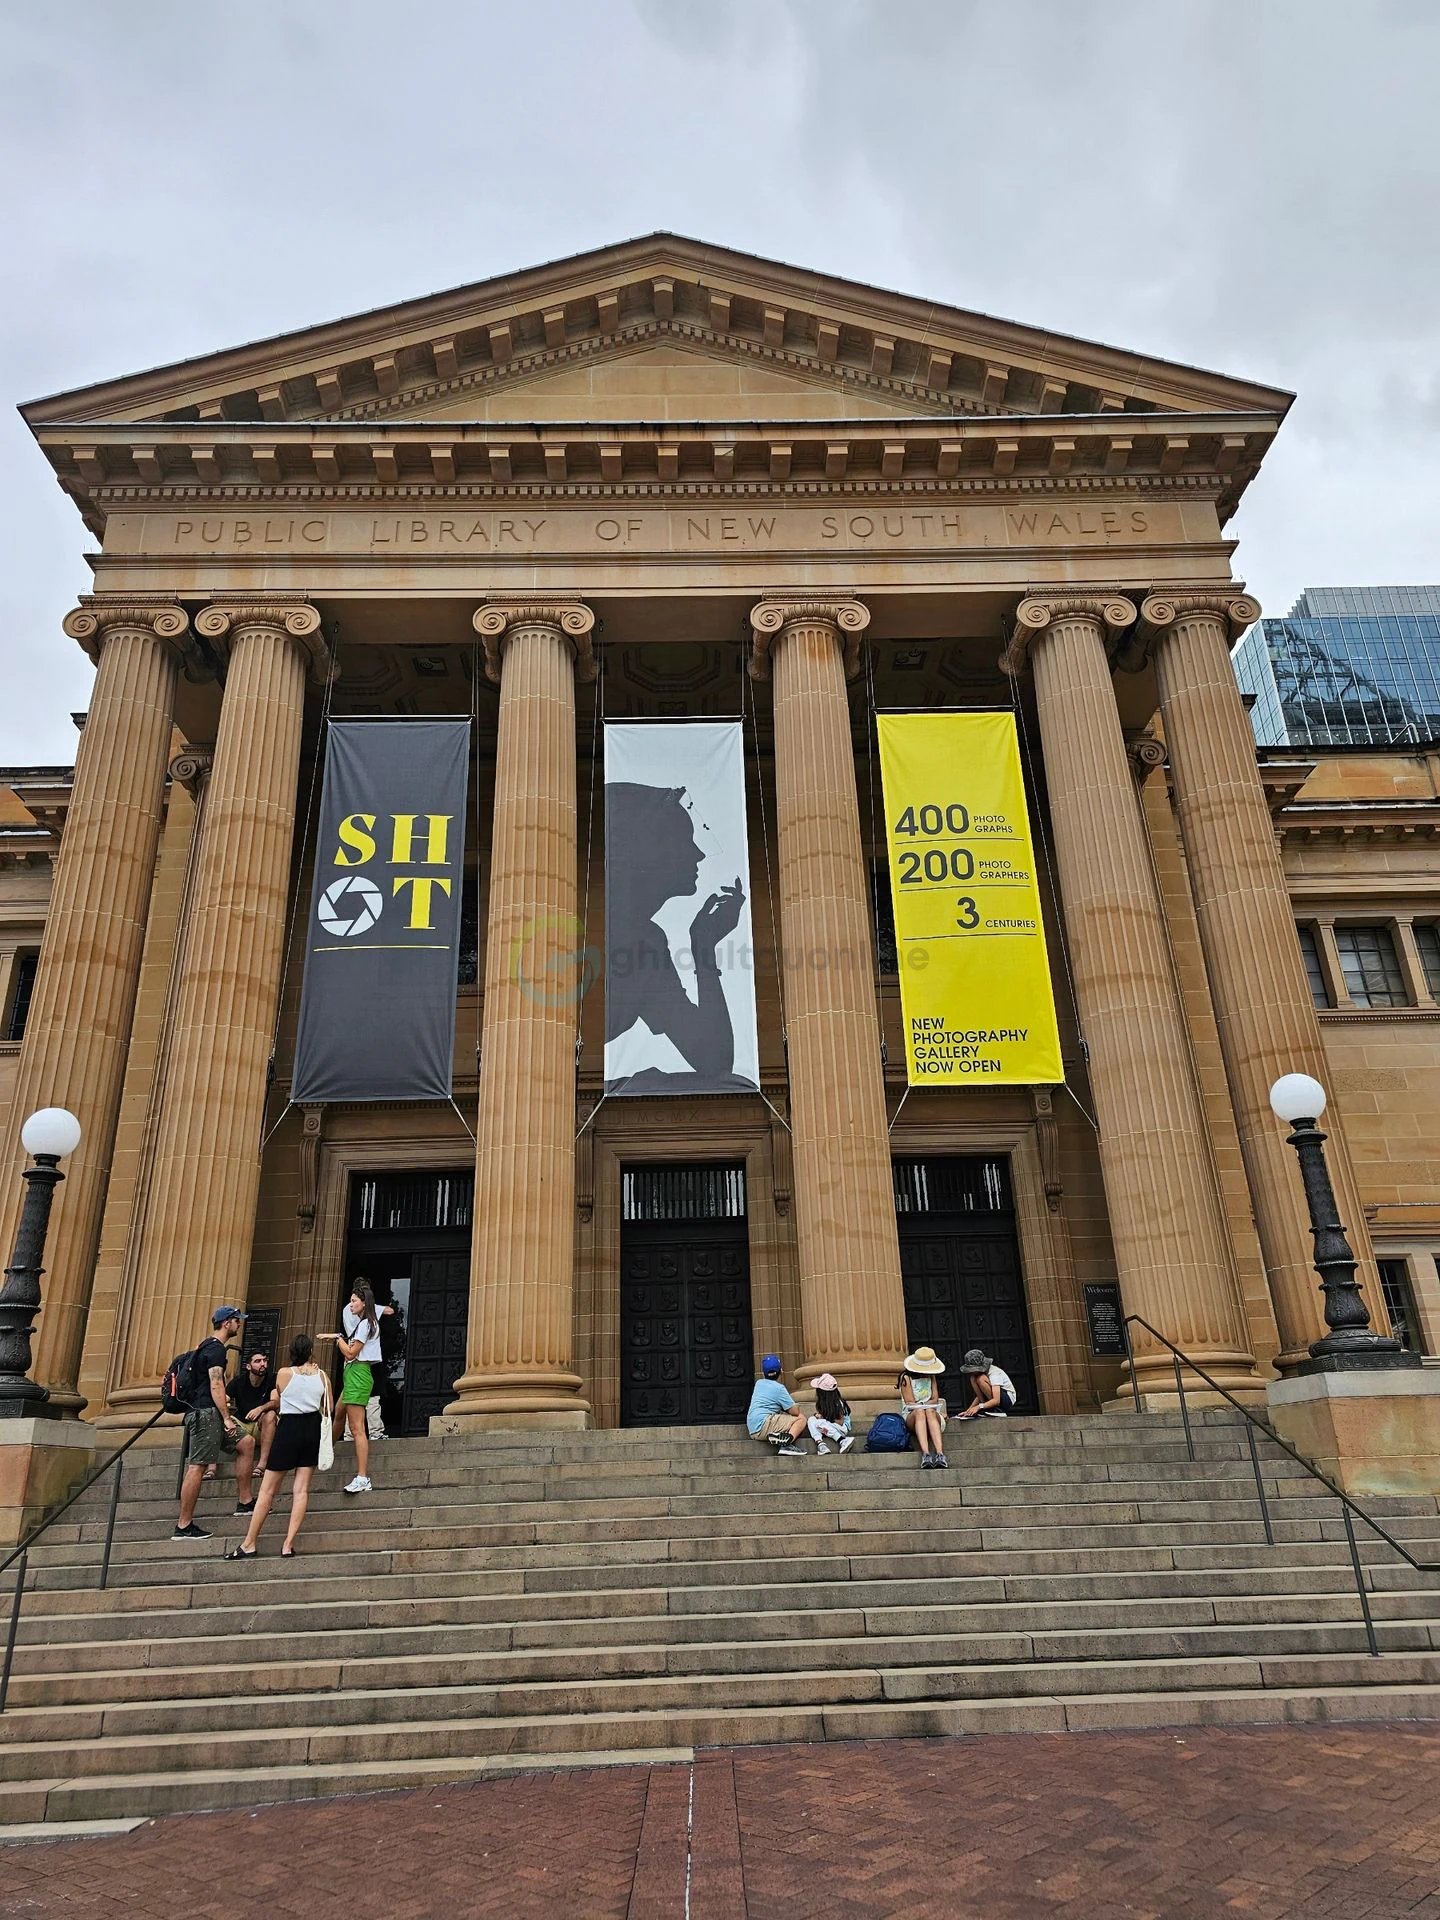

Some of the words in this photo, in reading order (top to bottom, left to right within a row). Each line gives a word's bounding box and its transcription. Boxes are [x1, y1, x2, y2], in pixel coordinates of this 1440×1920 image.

[174, 520, 327, 544] PUBLIC
[369, 519, 548, 544] LIBRARY
[594, 519, 644, 542] OF
[686, 517, 777, 541] NEW
[820, 514, 962, 539] SOUTH
[1008, 511, 1149, 535] WALES
[894, 804, 970, 837] 400
[973, 815, 1006, 823] PHOTO
[974, 825, 1013, 833] GRAPHS
[898, 848, 975, 885] 200
[978, 861, 1011, 869] PHOTO
[980, 871, 1030, 880] GRAPHERS
[956, 896, 980, 929] 3
[985, 920, 1036, 928] CENTURIES
[911, 1017, 945, 1030] NEW
[913, 1029, 1028, 1044] PHOTOGRAPHY
[914, 1046, 980, 1059] GALLERY
[915, 1061, 953, 1073] NOW
[958, 1060, 1001, 1073] OPEN
